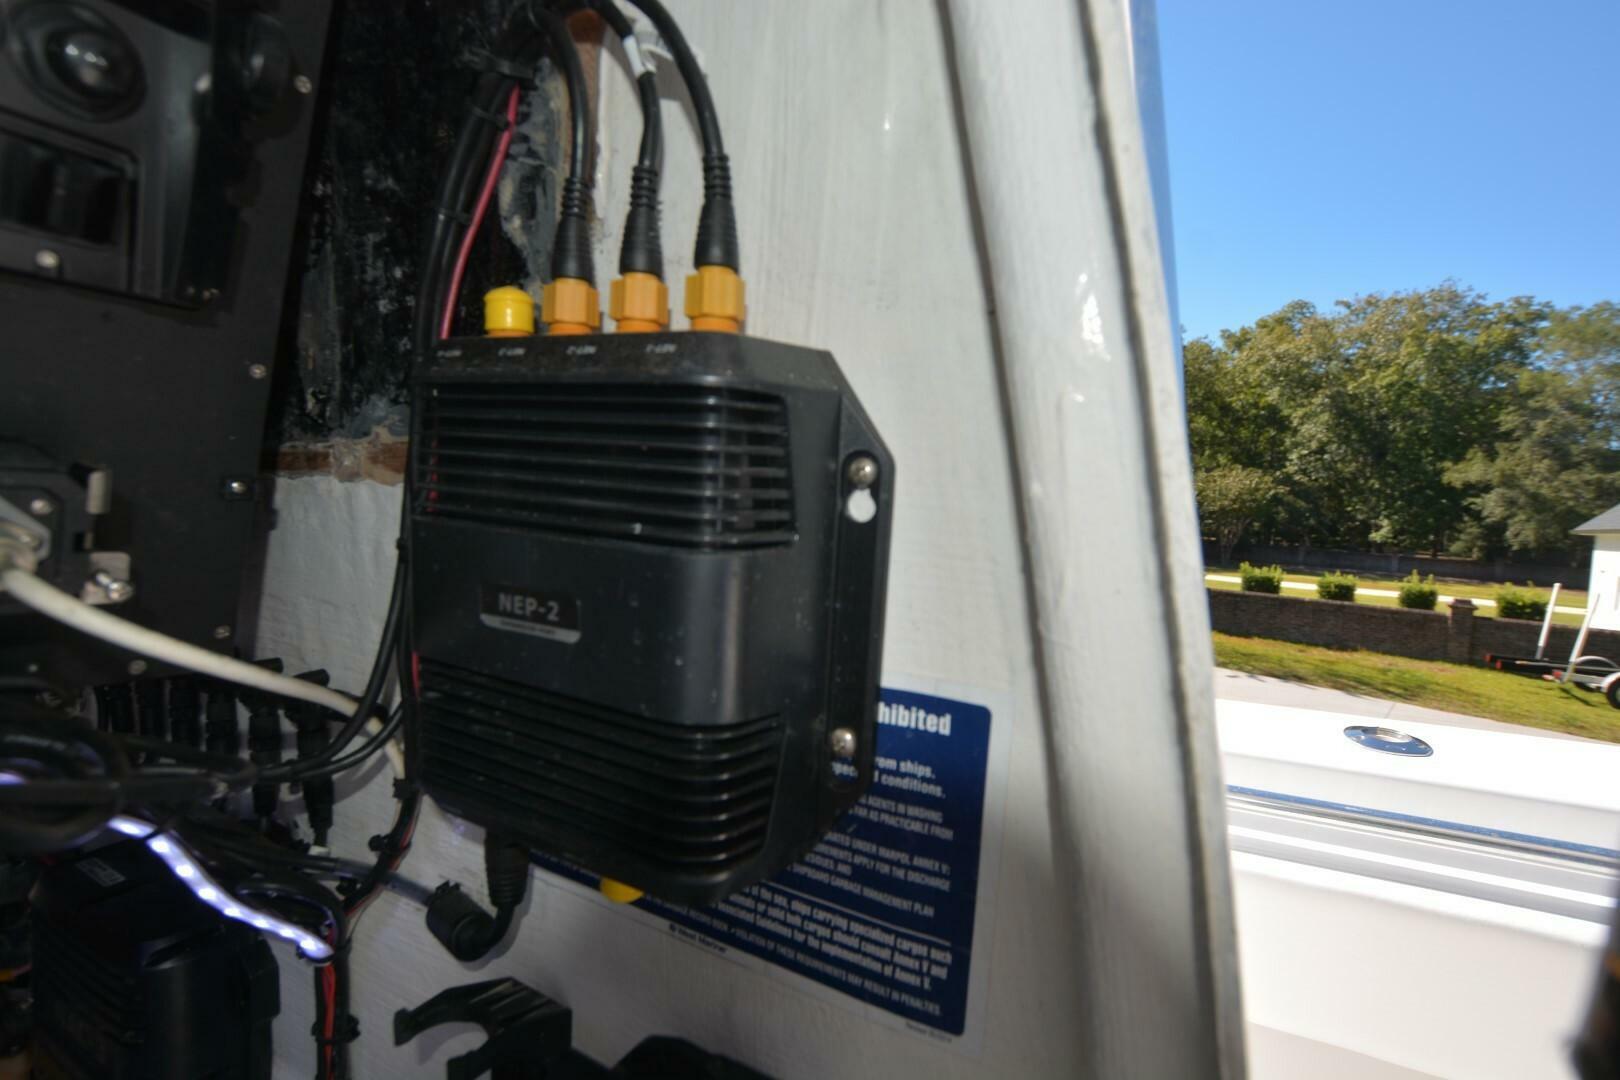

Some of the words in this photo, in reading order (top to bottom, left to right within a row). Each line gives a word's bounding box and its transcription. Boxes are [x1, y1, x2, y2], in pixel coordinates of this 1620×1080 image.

[498, 593, 560, 621] NEP-2
[877, 701, 951, 736] hibited
[874, 757, 897, 770] rom
[899, 760, 936, 779] ships.
[881, 774, 946, 799] conditions.
[880, 812, 929, 836] PRACTICABLE
